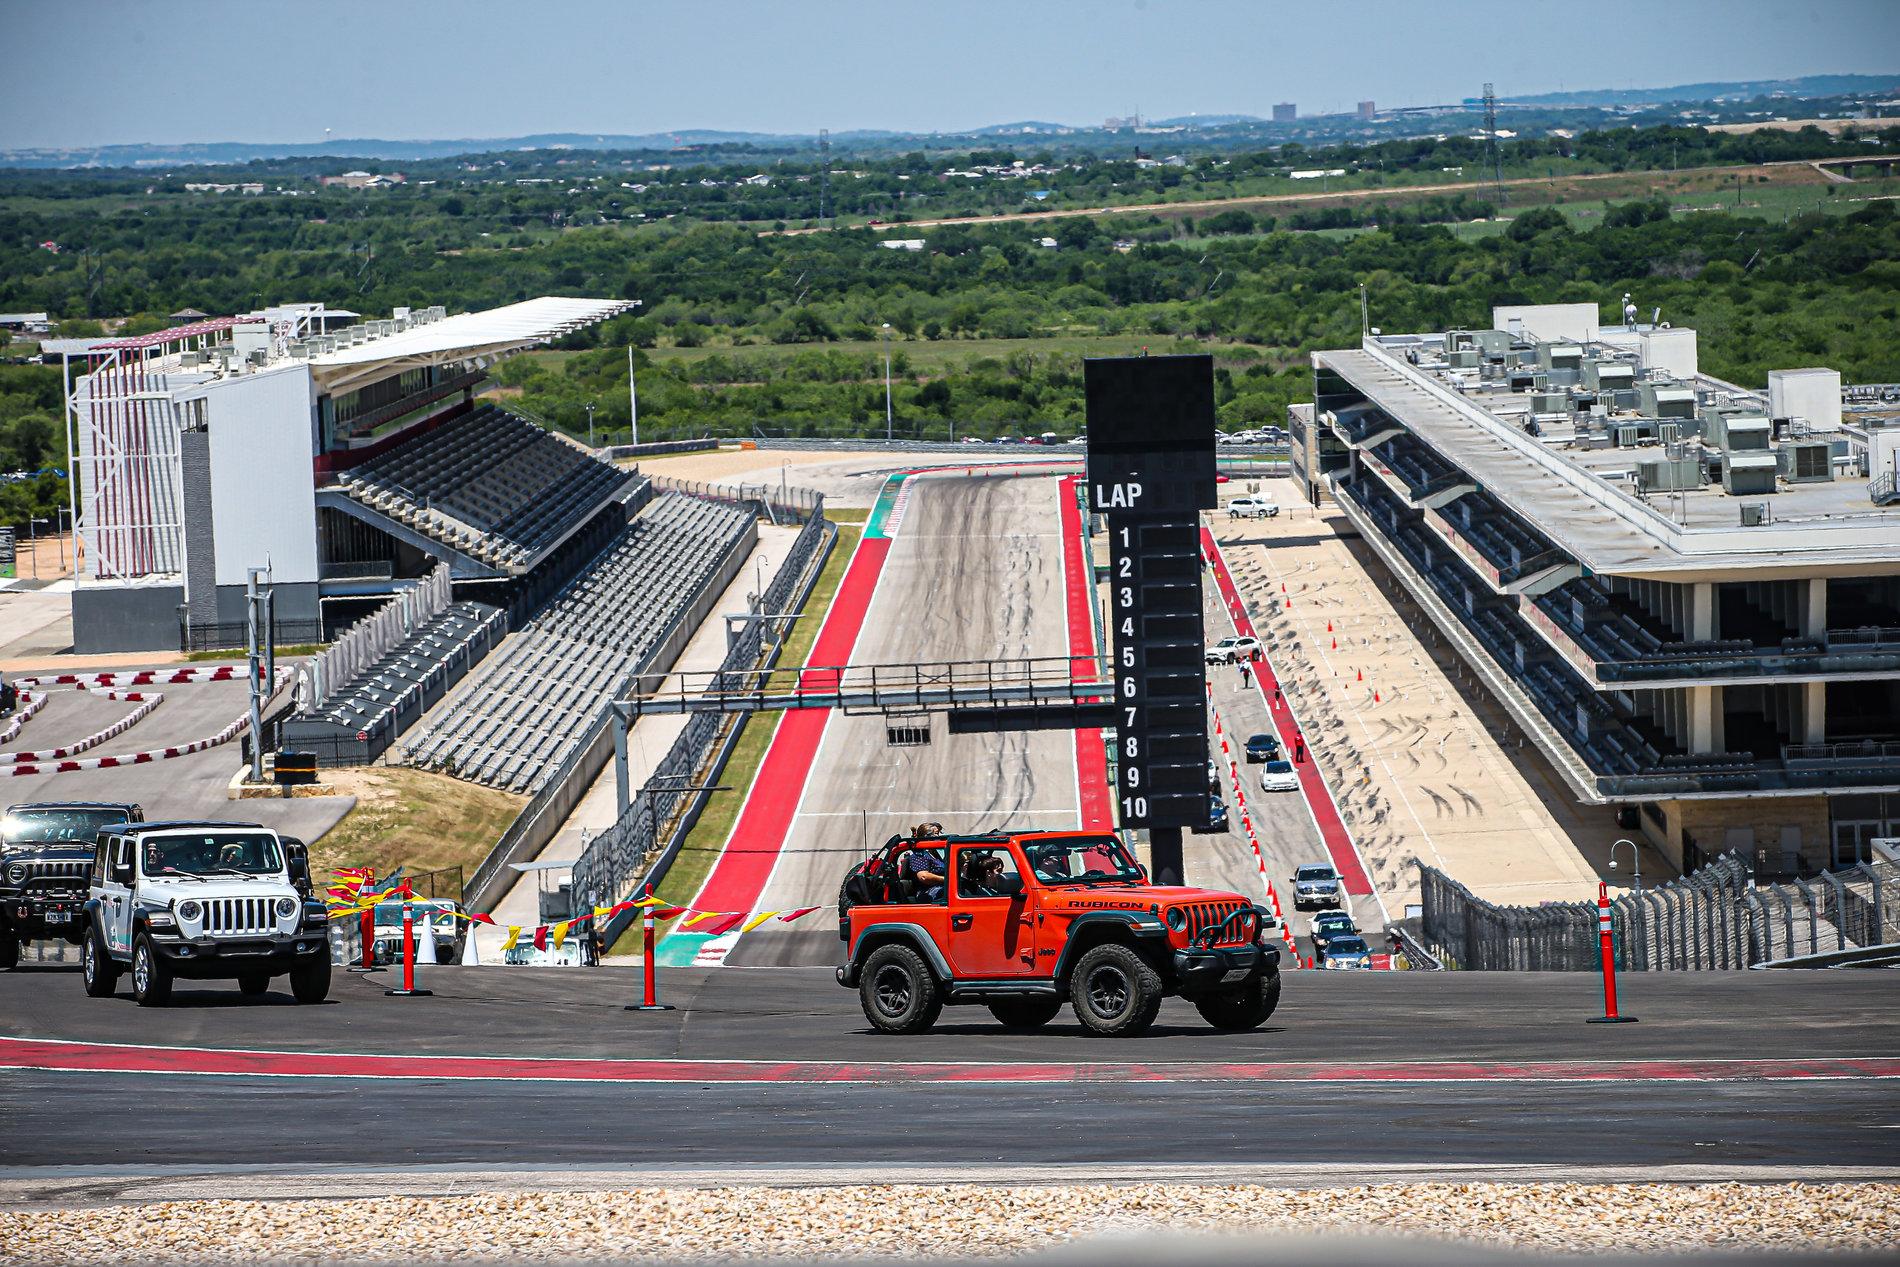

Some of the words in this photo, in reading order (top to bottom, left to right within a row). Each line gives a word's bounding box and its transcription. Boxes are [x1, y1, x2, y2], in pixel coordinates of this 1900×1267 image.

[1096, 482, 1143, 508] LAP
[1119, 526, 1130, 548] 1
[1119, 556, 1132, 578] 2
[1120, 587, 1133, 608] 3
[1121, 617, 1134, 637] 4
[1123, 646, 1135, 667] 5
[1123, 677, 1136, 698] 6
[1124, 707, 1137, 727] 7
[1126, 736, 1138, 758] 8
[1127, 766, 1140, 788] 9
[1122, 796, 1147, 819] 10
[1068, 900, 1144, 909] RUBICON
